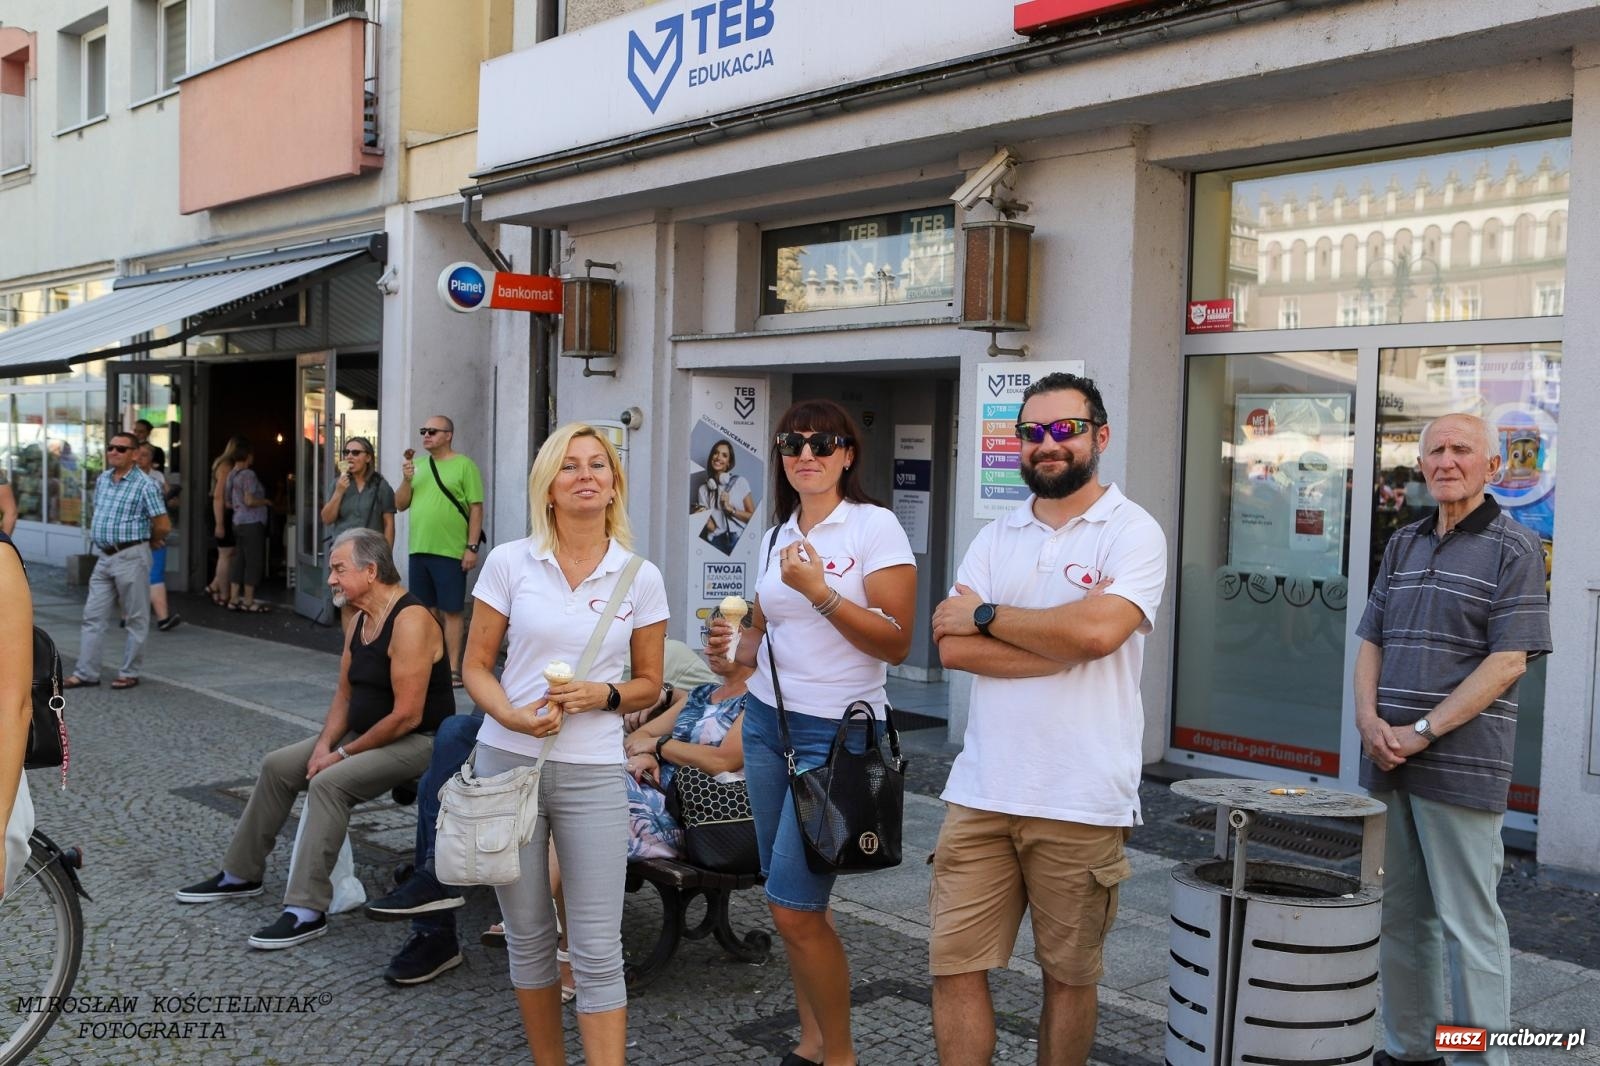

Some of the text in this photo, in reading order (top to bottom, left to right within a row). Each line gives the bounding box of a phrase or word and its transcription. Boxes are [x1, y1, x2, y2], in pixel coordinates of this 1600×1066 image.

[691, 0, 775, 55] TEB
[688, 48, 774, 88] EDUKACJA
[848, 223, 878, 241] TEB
[910, 214, 945, 234] TEB
[451, 279, 482, 293] Planet
[498, 285, 554, 300] bankomat
[1007, 374, 1030, 386] TEB
[734, 387, 755, 396] TEB
[720, 426, 750, 449] POLICEALNE
[707, 565, 742, 574] TWOJA
[1192, 732, 1322, 767] drogeria-perfumeria
